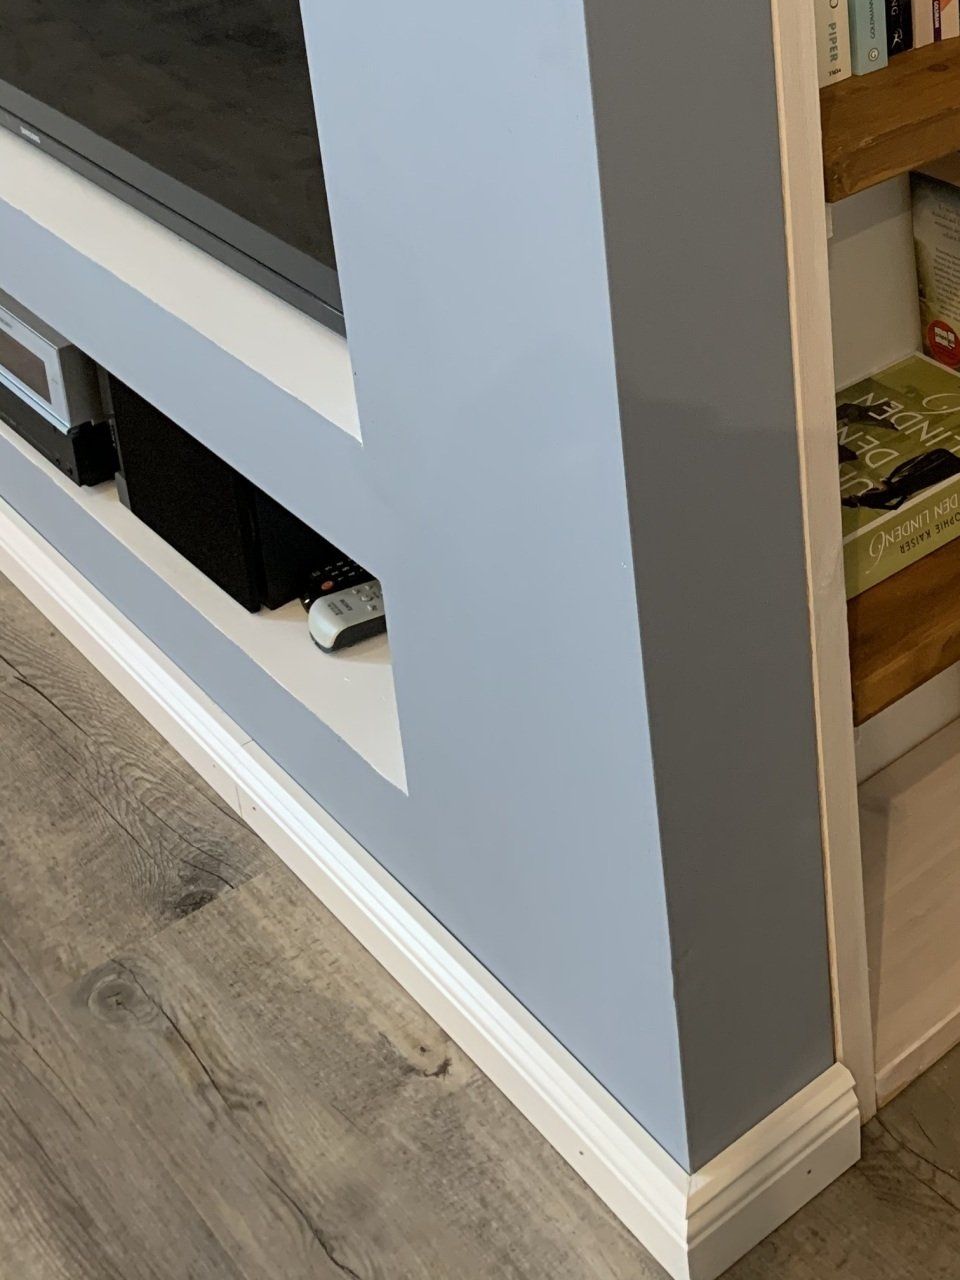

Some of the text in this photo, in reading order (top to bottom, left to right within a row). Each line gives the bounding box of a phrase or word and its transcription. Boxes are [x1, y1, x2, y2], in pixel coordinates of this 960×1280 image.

[828, 22, 839, 63] PIPER
[836, 425, 900, 469] DEN
[934, 494, 959, 518] DEN
[886, 510, 930, 547] LINDEN
[900, 528, 931, 555] KAISER
